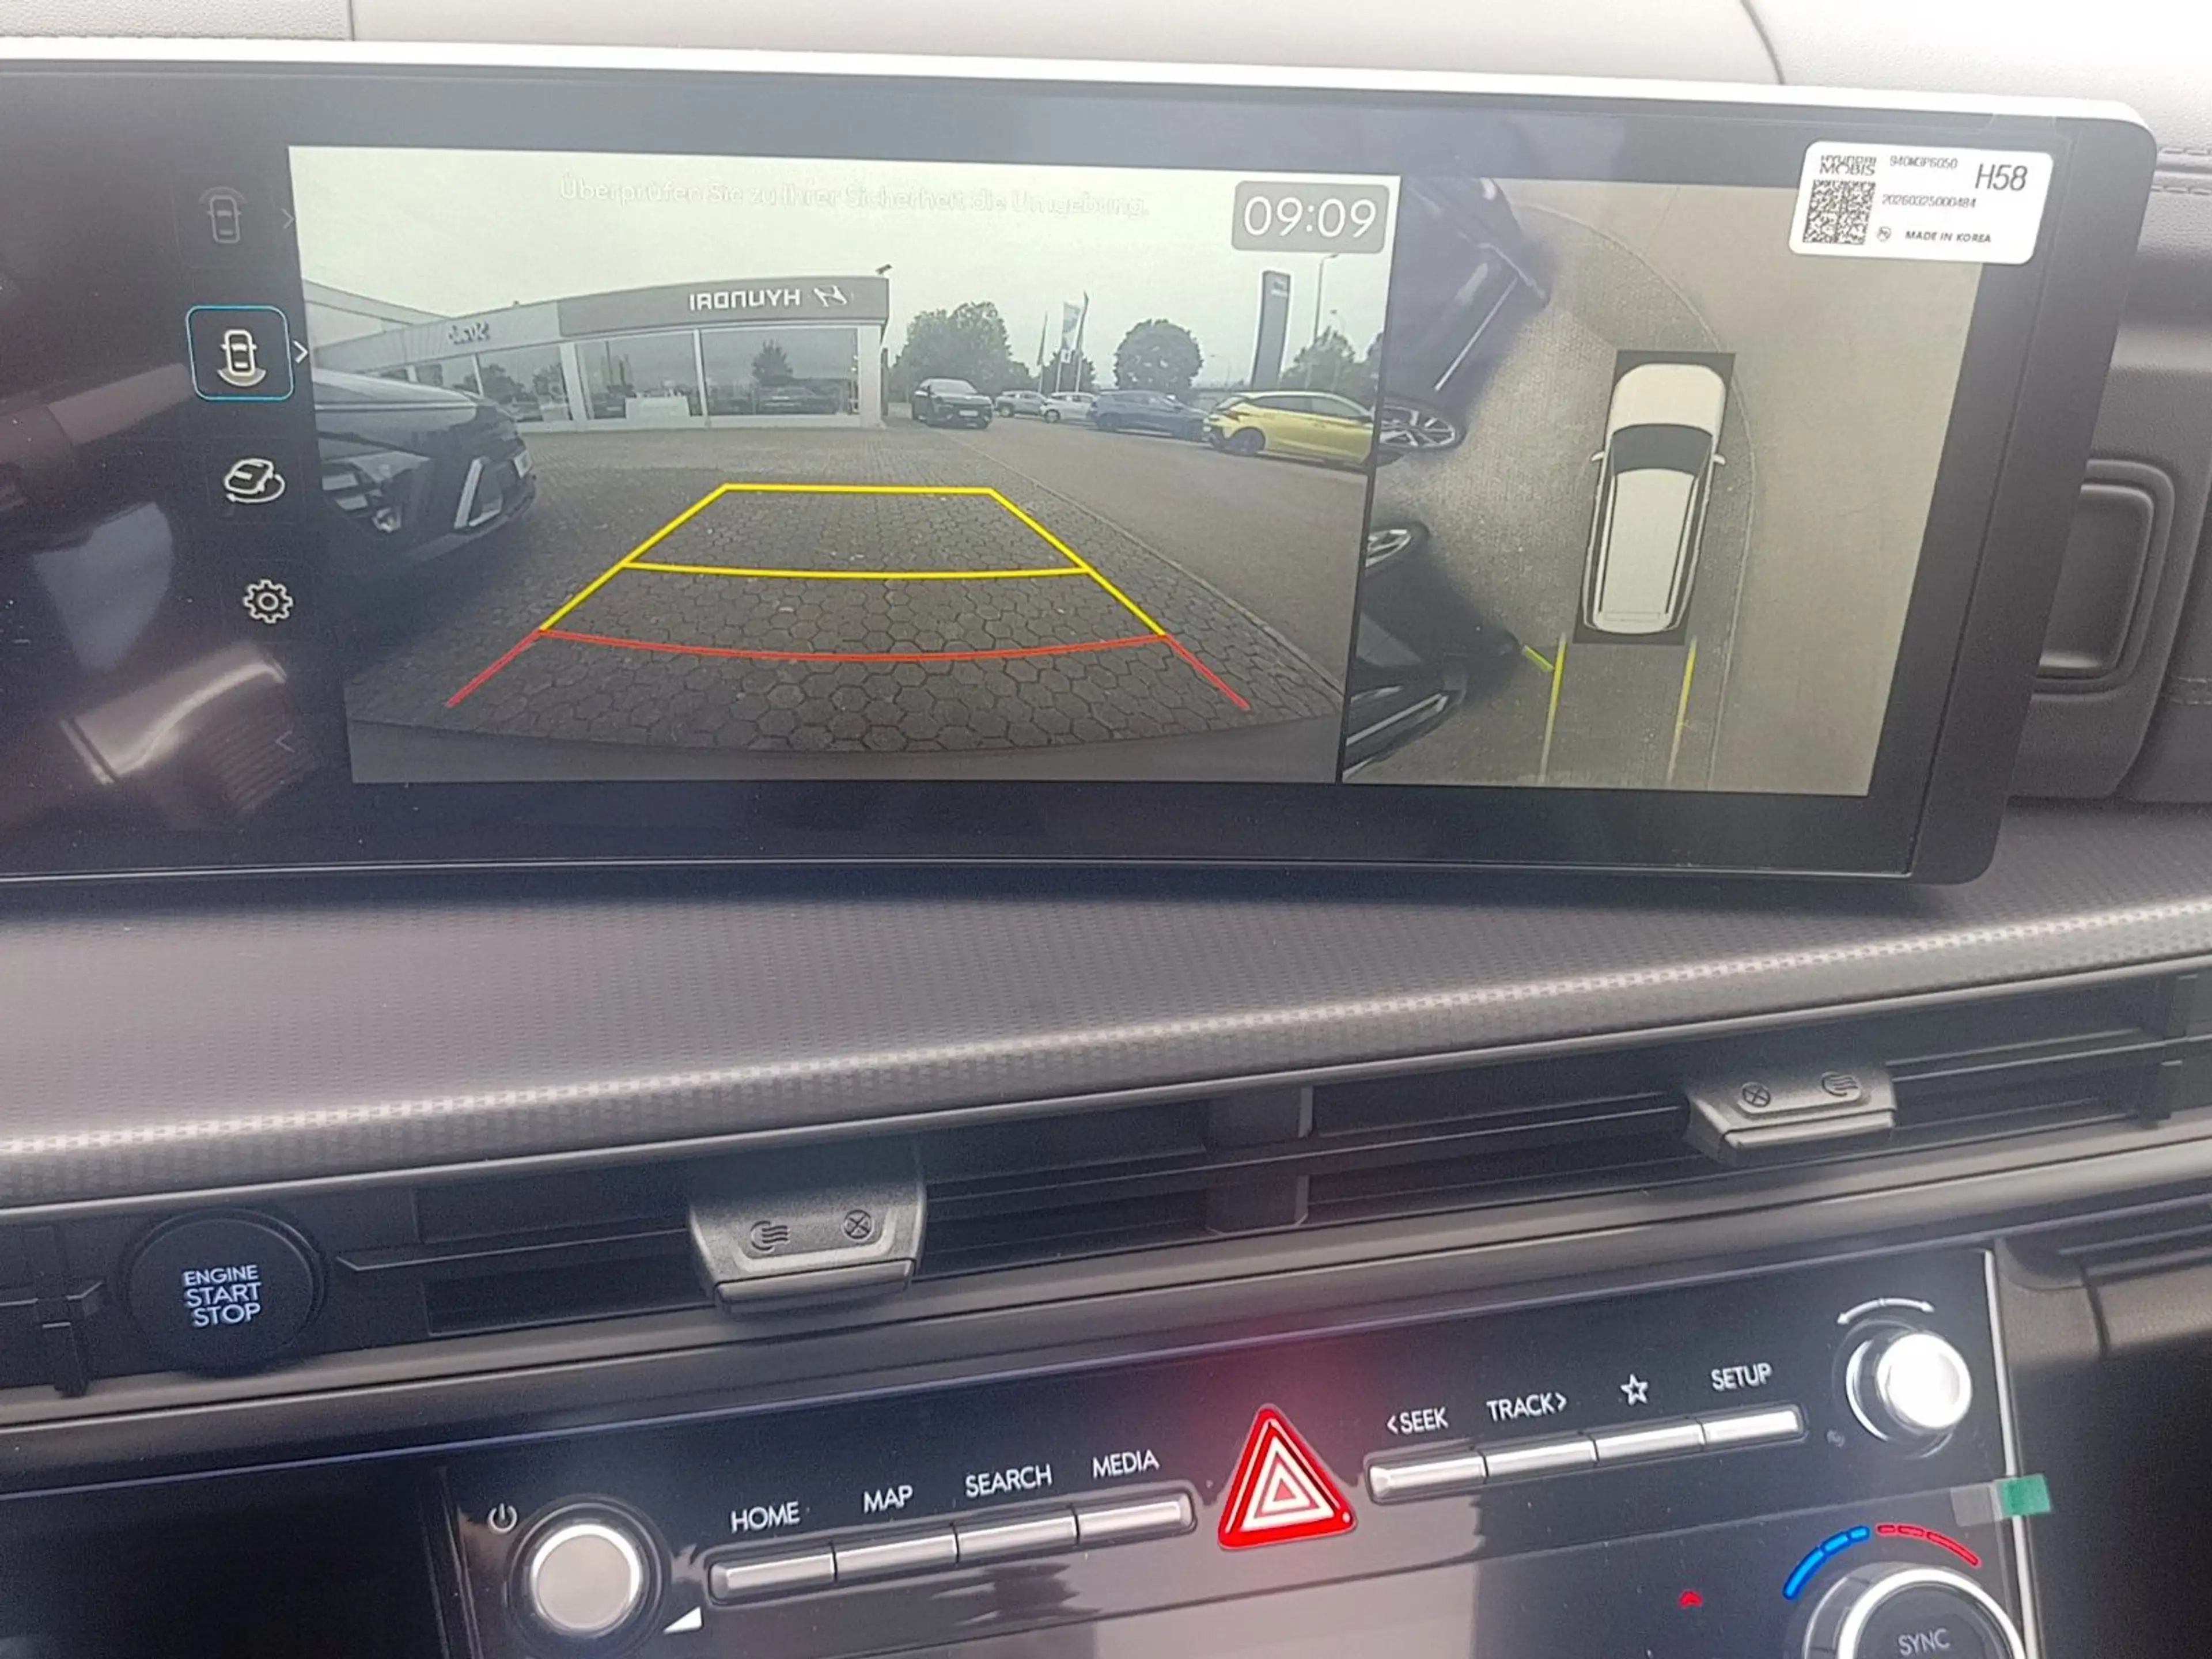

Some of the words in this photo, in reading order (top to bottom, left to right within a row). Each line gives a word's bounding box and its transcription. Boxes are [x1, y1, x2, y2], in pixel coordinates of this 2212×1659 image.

[1819, 162, 1876, 176] MOBIS
[1975, 164, 2028, 191] H58
[560, 173, 700, 206] Überprüfen
[709, 181, 743, 202] Sie
[749, 188, 777, 206] zu
[845, 185, 965, 211] Sicherheit
[1244, 196, 1377, 238] 09:09
[1905, 230, 1937, 240] MADE
[1940, 232, 1953, 241] IN
[1956, 233, 1991, 243] KOREA
[183, 1264, 259, 1286] ENGINE
[184, 1282, 262, 1308] START
[191, 1302, 261, 1327] STOP
[1711, 1362, 1772, 1392] SETUP
[1093, 1449, 1160, 1479] MEDIA
[965, 1464, 1053, 1498] SEARCH
[863, 1484, 914, 1514] MAP
[730, 1501, 801, 1533] HOME
[1897, 1628, 1950, 1657] SYNC
